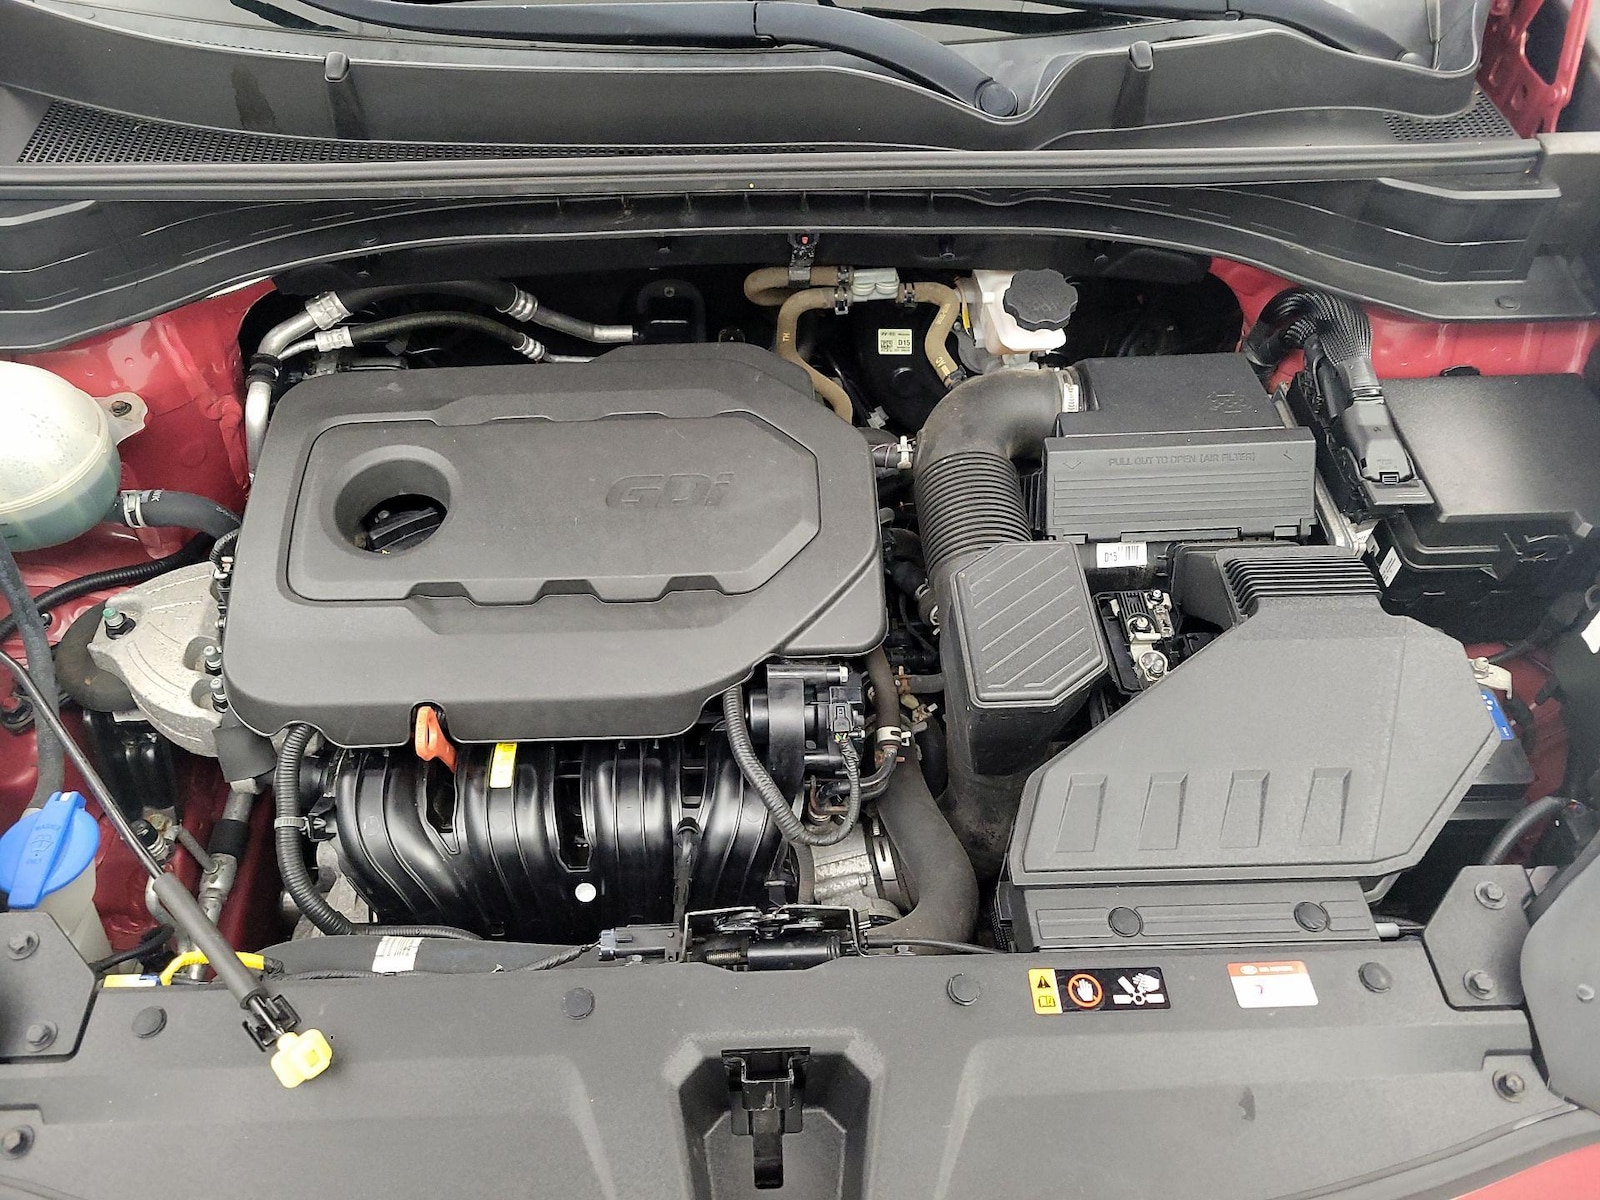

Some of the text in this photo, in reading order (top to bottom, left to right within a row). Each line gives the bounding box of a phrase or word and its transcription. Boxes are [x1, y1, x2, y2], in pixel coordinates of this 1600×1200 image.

[1108, 457, 1132, 466] PULL
[1134, 456, 1153, 465] OUT
[1156, 456, 1168, 464] TO
[1170, 454, 1196, 464] OPEN
